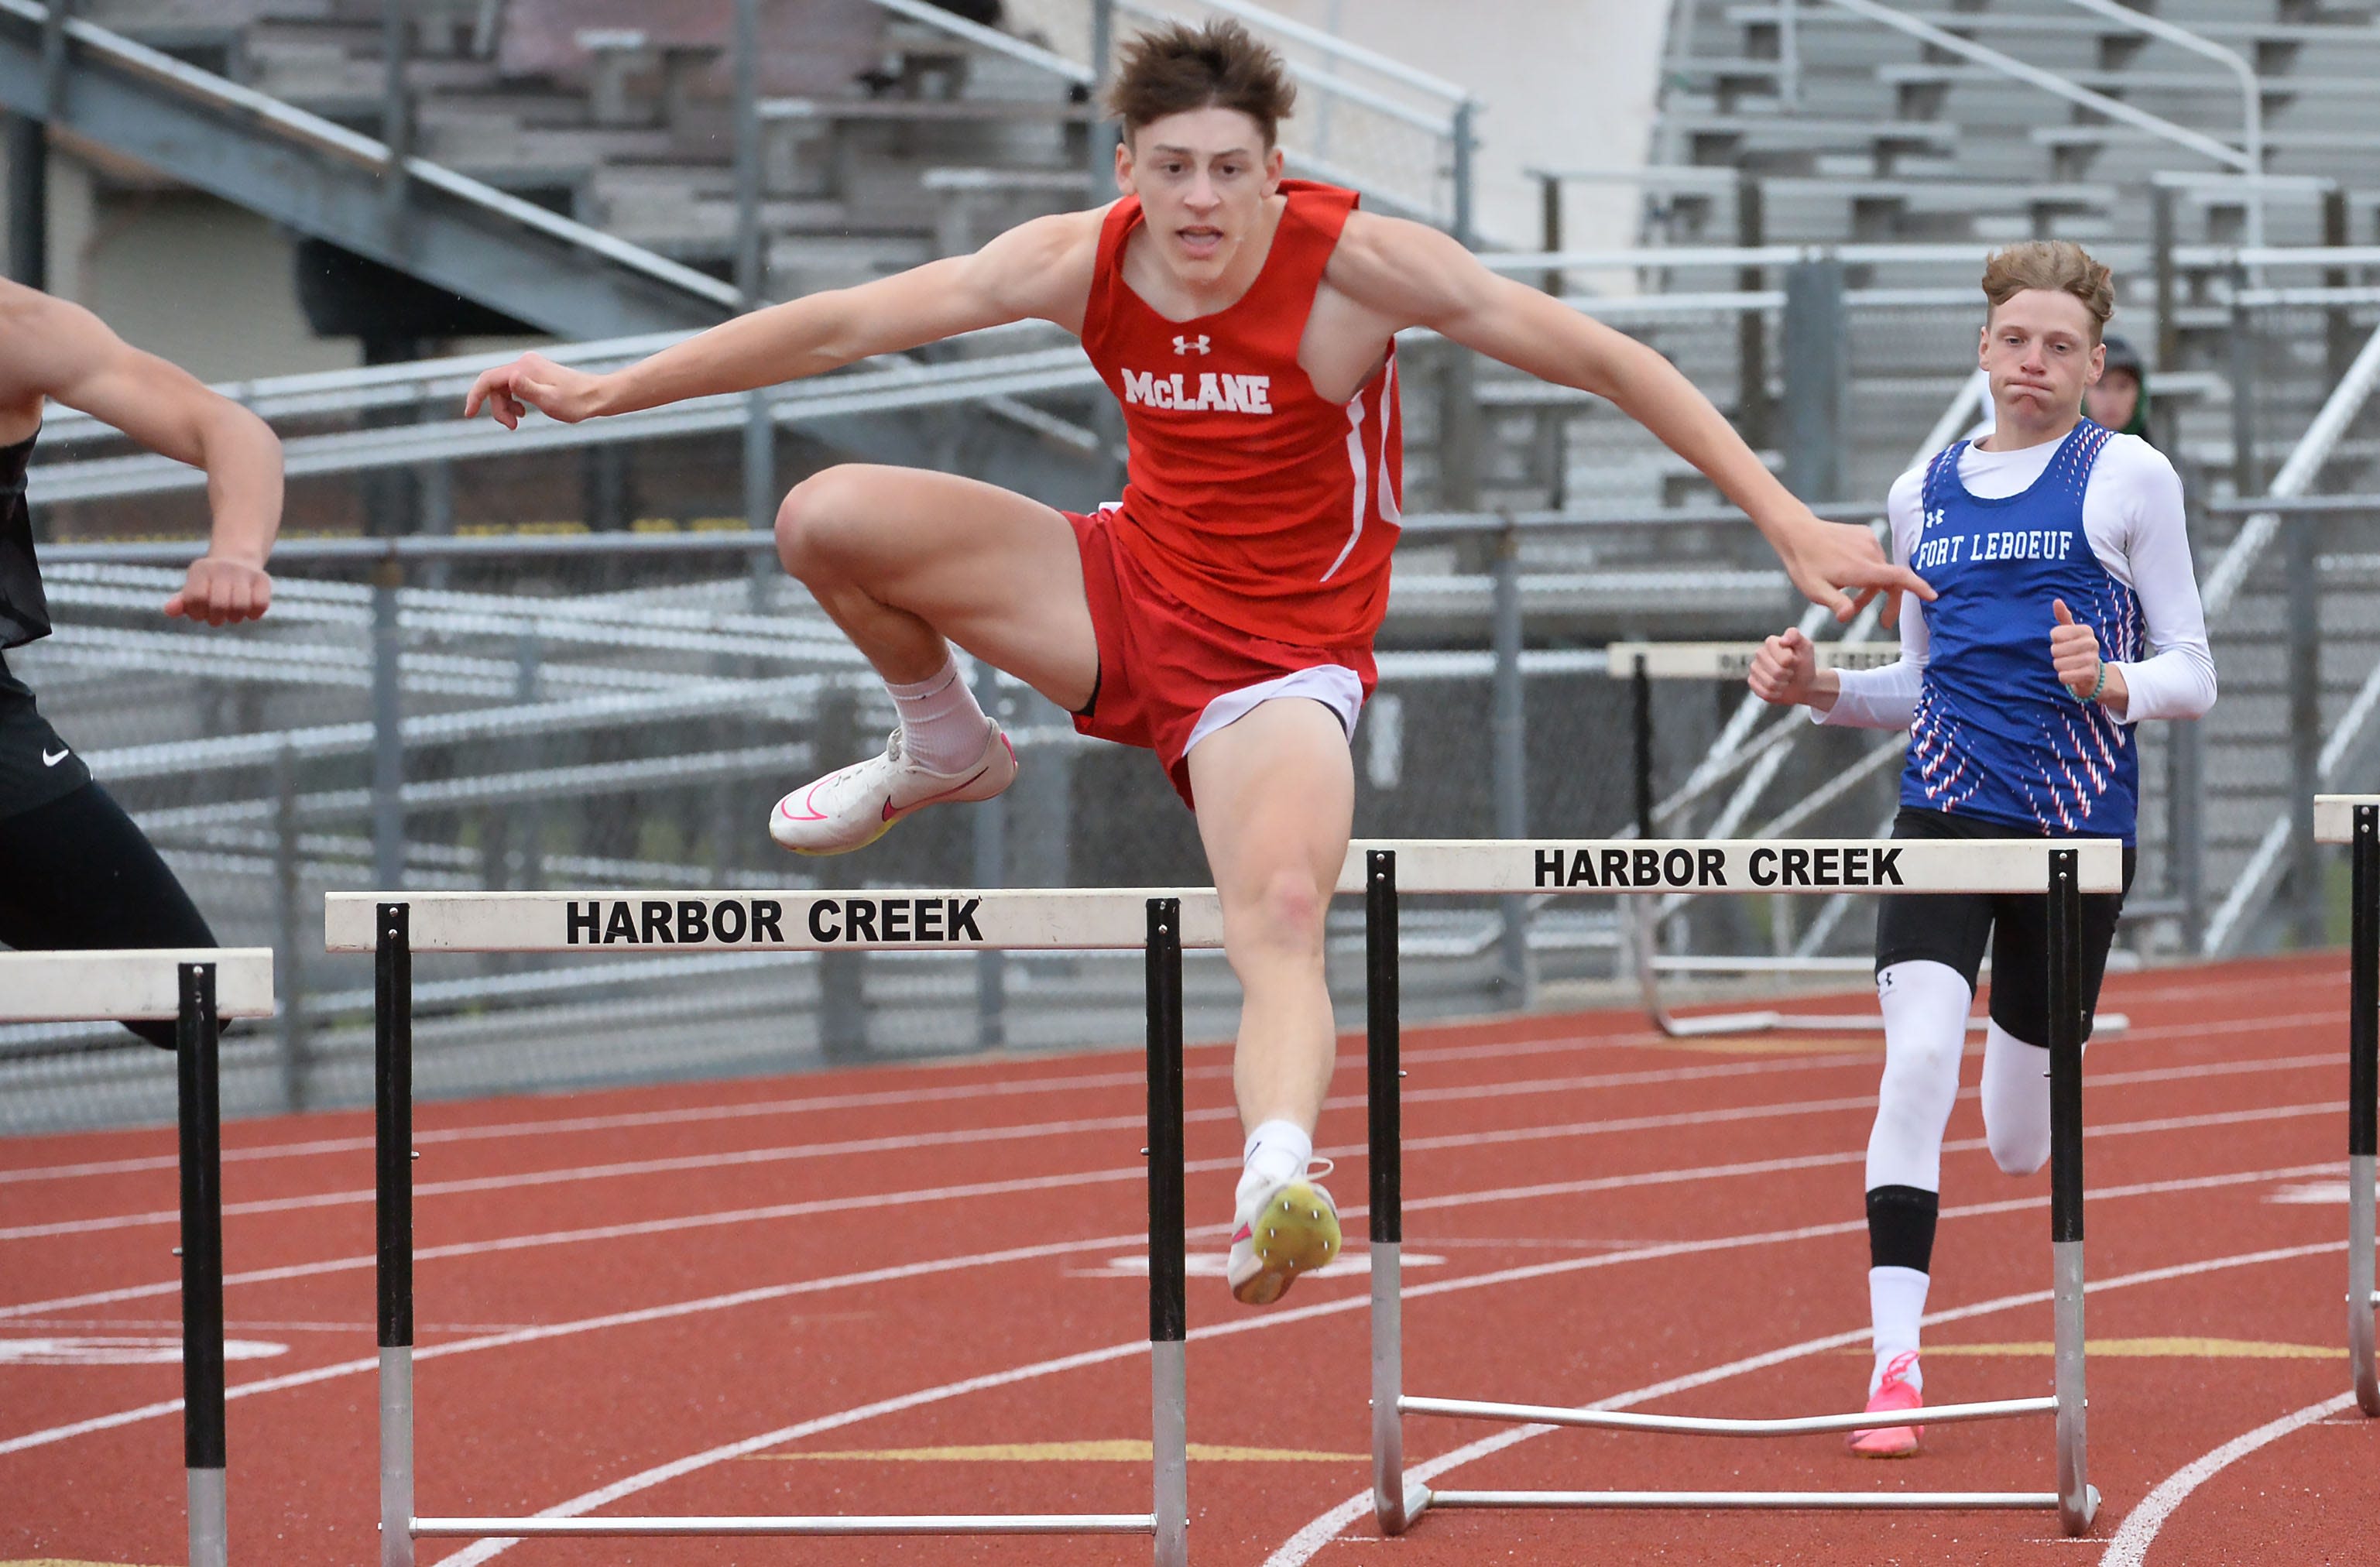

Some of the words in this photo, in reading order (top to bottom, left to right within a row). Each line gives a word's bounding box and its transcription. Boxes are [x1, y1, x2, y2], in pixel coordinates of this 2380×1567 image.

[1121, 368, 1273, 414] McLANE
[1915, 535, 1965, 571] FORT
[1970, 530, 2073, 561] LEBOEUF
[1535, 849, 1727, 887] HARBOR
[1749, 848, 1904, 886] CREEK
[567, 900, 784, 945] HARBOR
[808, 897, 984, 942] CREEK
